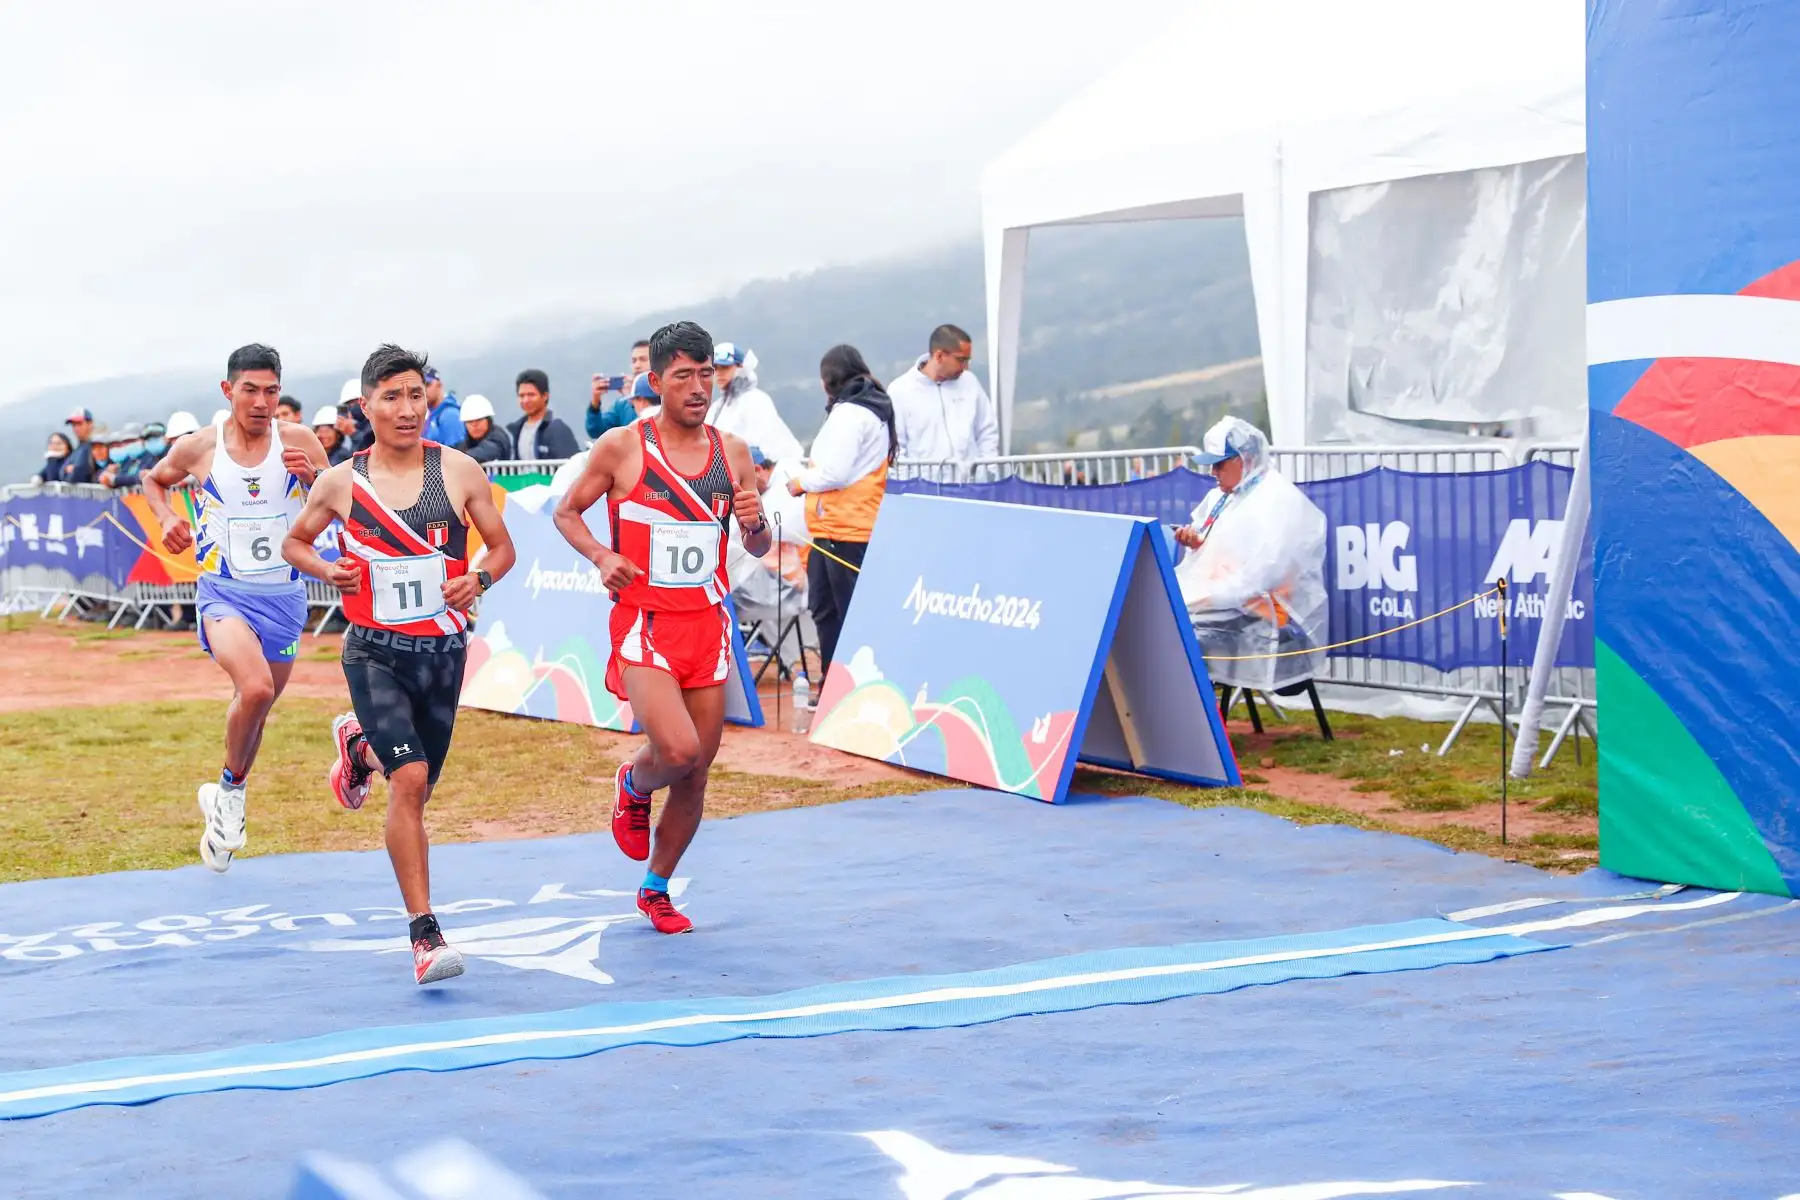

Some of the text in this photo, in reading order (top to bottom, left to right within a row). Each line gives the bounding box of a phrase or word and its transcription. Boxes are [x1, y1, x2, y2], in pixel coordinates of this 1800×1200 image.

[241, 499, 268, 507] ECUADOR
[644, 489, 670, 500] PERÚ
[251, 536, 272, 562] 6
[666, 546, 704, 575] 10
[1336, 520, 1418, 592] BIG
[524, 557, 609, 600] Ayacucho20
[392, 580, 423, 610] 11
[1369, 596, 1415, 619] COLA
[1514, 592, 1585, 620] Athic
